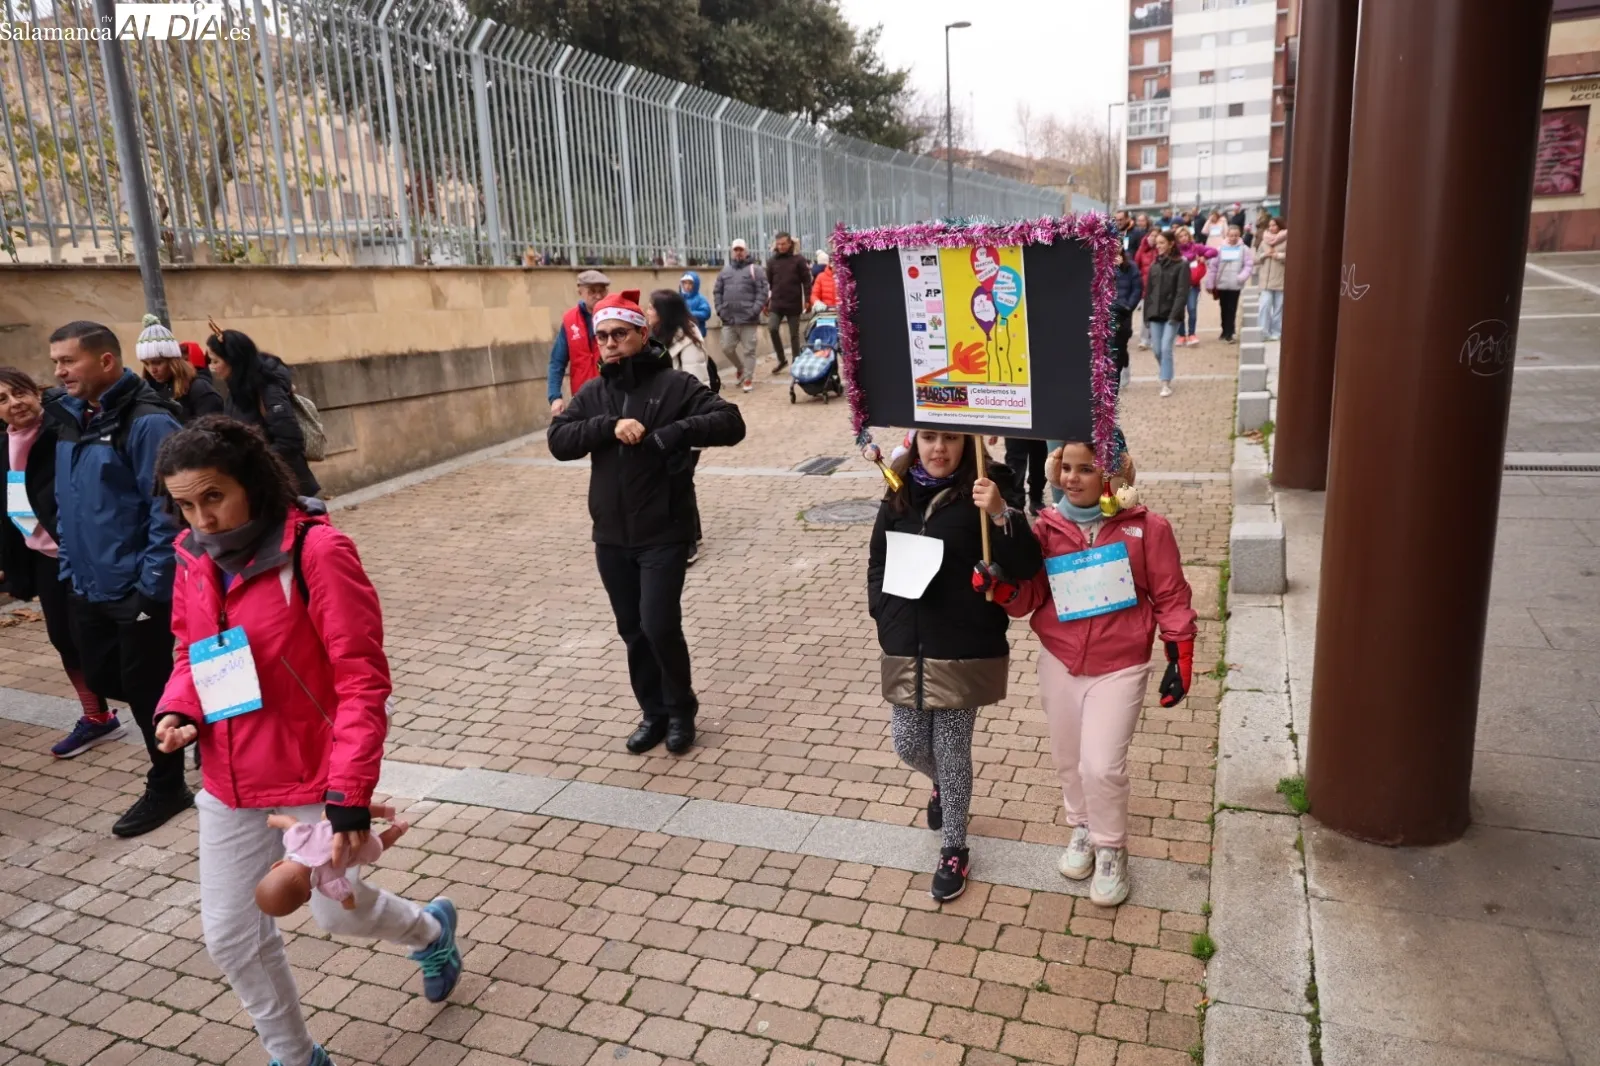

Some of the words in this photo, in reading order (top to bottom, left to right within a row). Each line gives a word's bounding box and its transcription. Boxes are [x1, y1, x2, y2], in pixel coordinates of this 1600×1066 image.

[916, 386, 968, 403] MARISTAS
[970, 387, 1009, 396] ¡Celebremos
[1010, 388, 1017, 396] la
[974, 397, 1027, 408] solidaridad!
[1072, 554, 1093, 565] unicef
